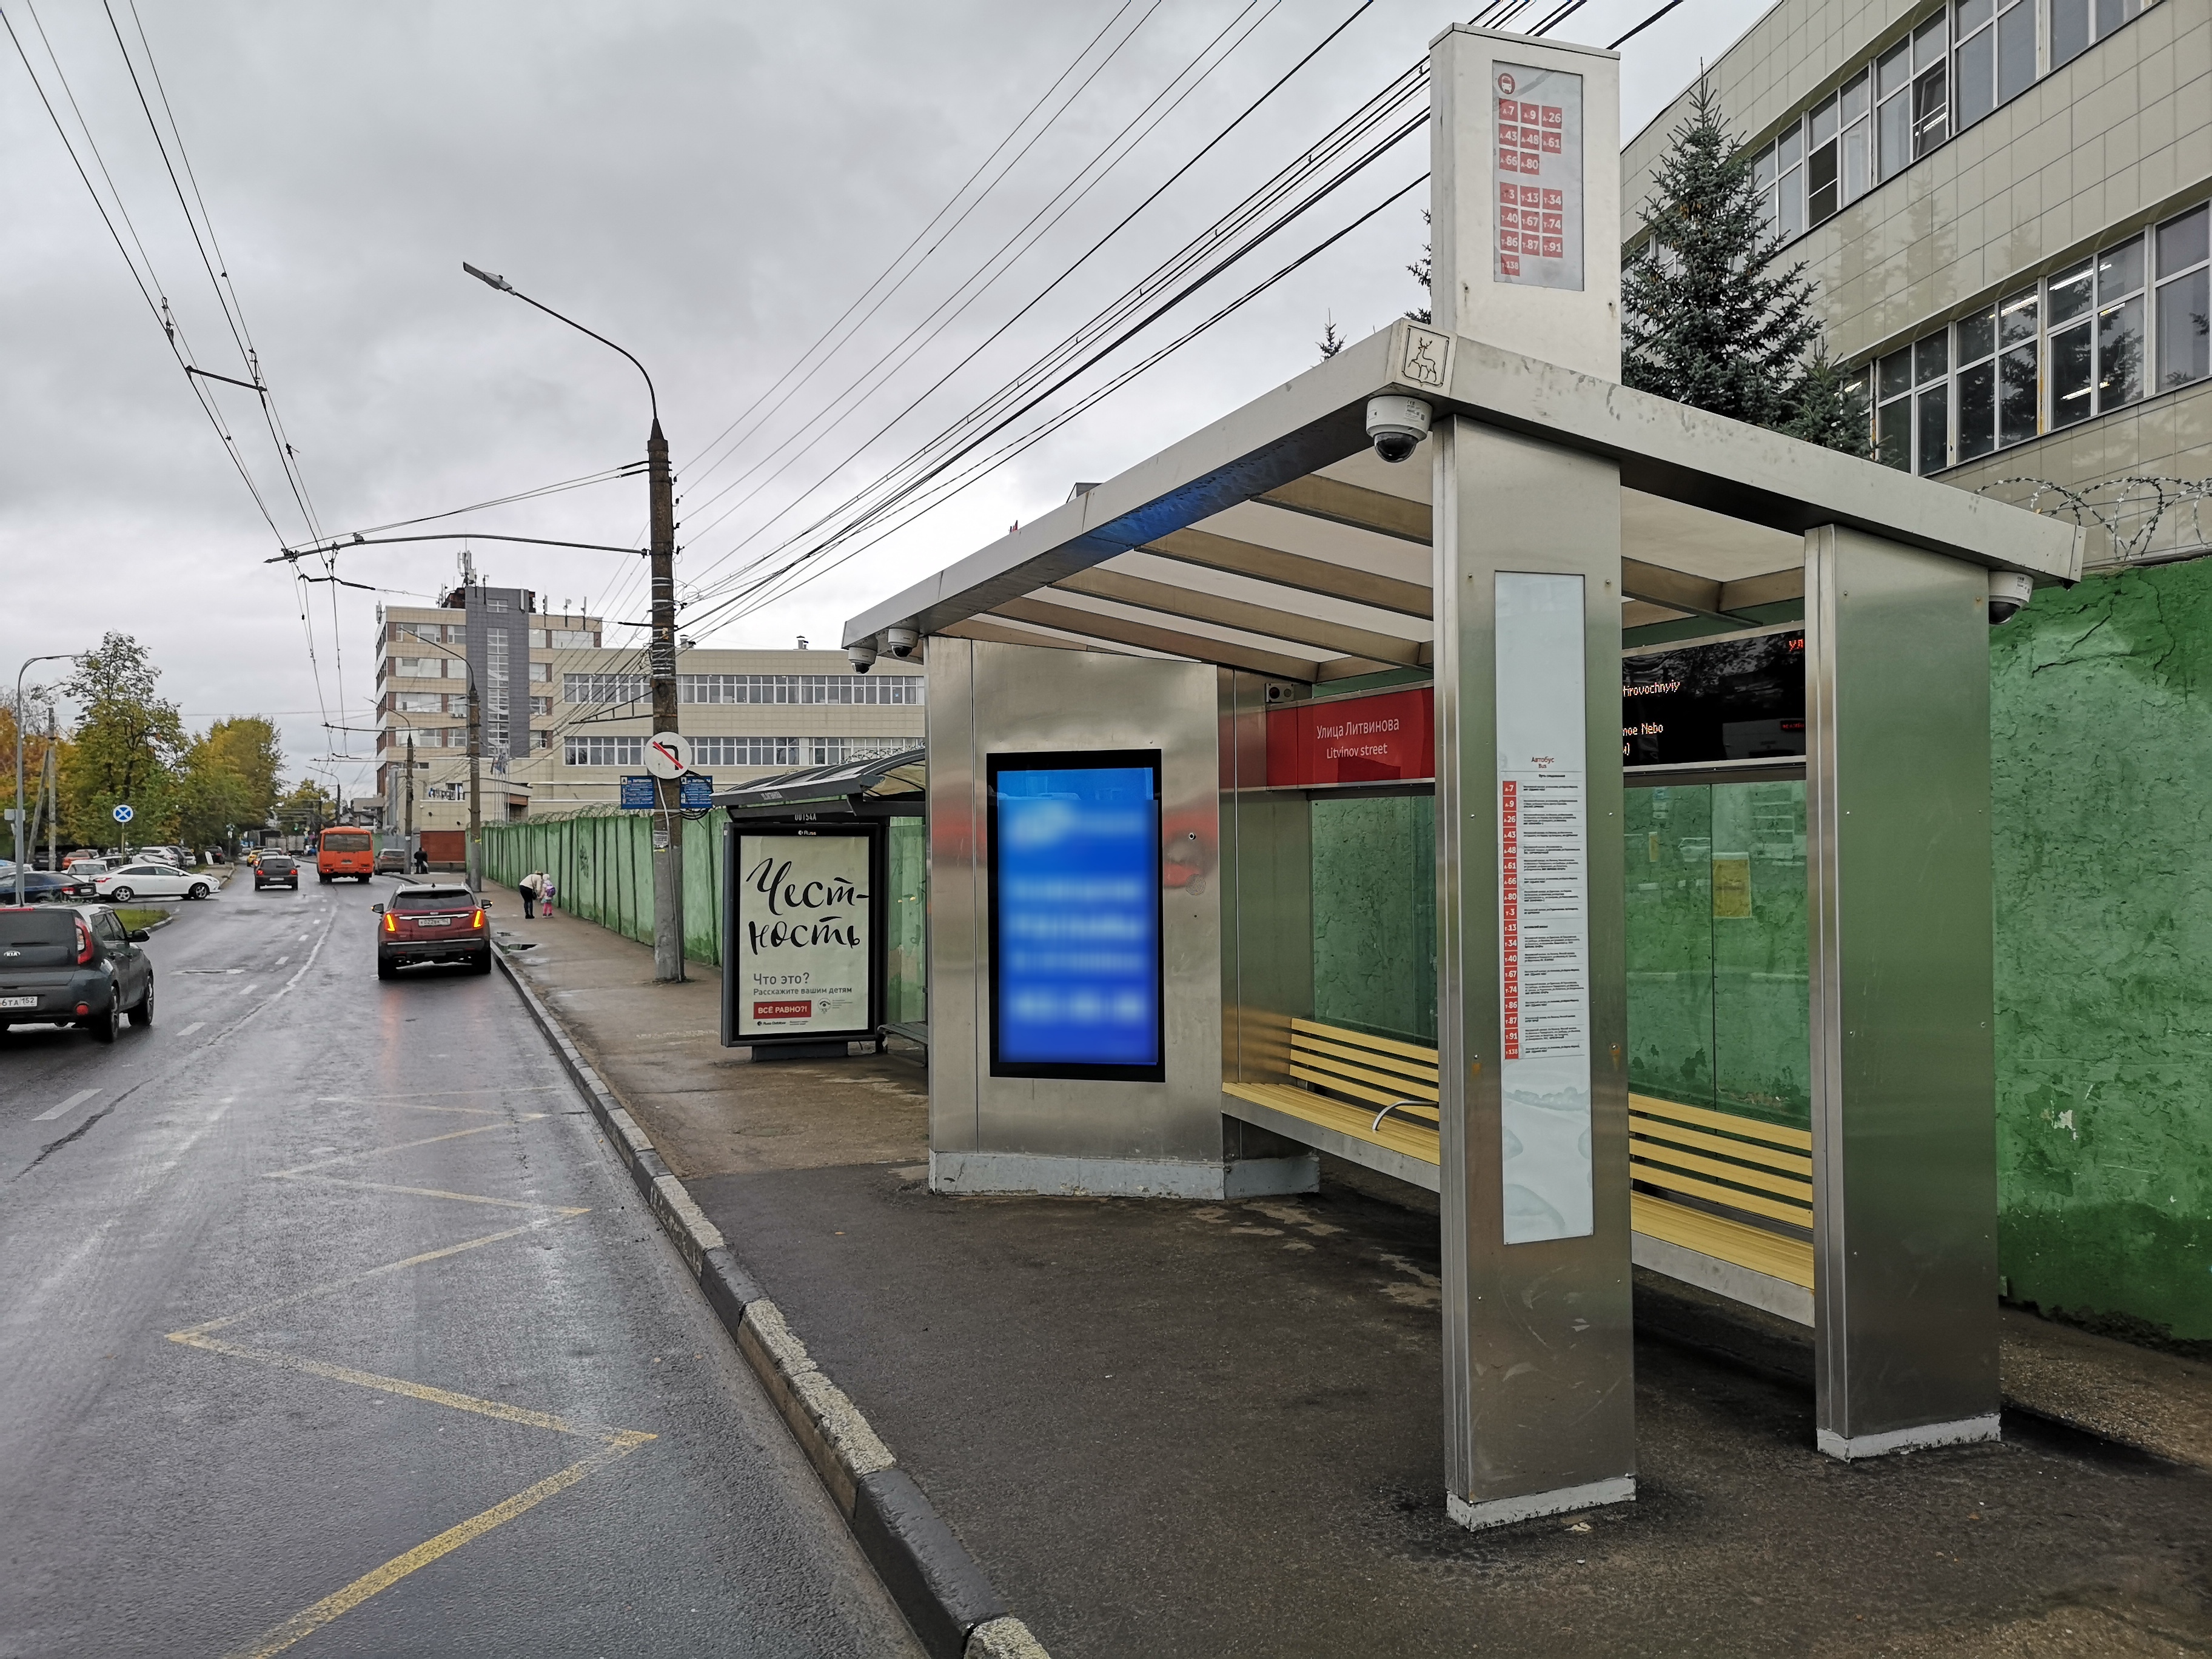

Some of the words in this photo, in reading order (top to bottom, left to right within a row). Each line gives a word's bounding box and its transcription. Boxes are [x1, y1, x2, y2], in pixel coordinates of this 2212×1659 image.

[1316, 725, 1344, 740] Улица
[1345, 718, 1399, 736] Литвинова
[1641, 722, 1664, 735] Nebo
[1326, 746, 1359, 759] Litvinov
[1360, 743, 1388, 756] street
[746, 857, 870, 916] Чест-
[748, 916, 860, 955] ность
[753, 973, 777, 985] Что
[780, 972, 809, 985] это?
